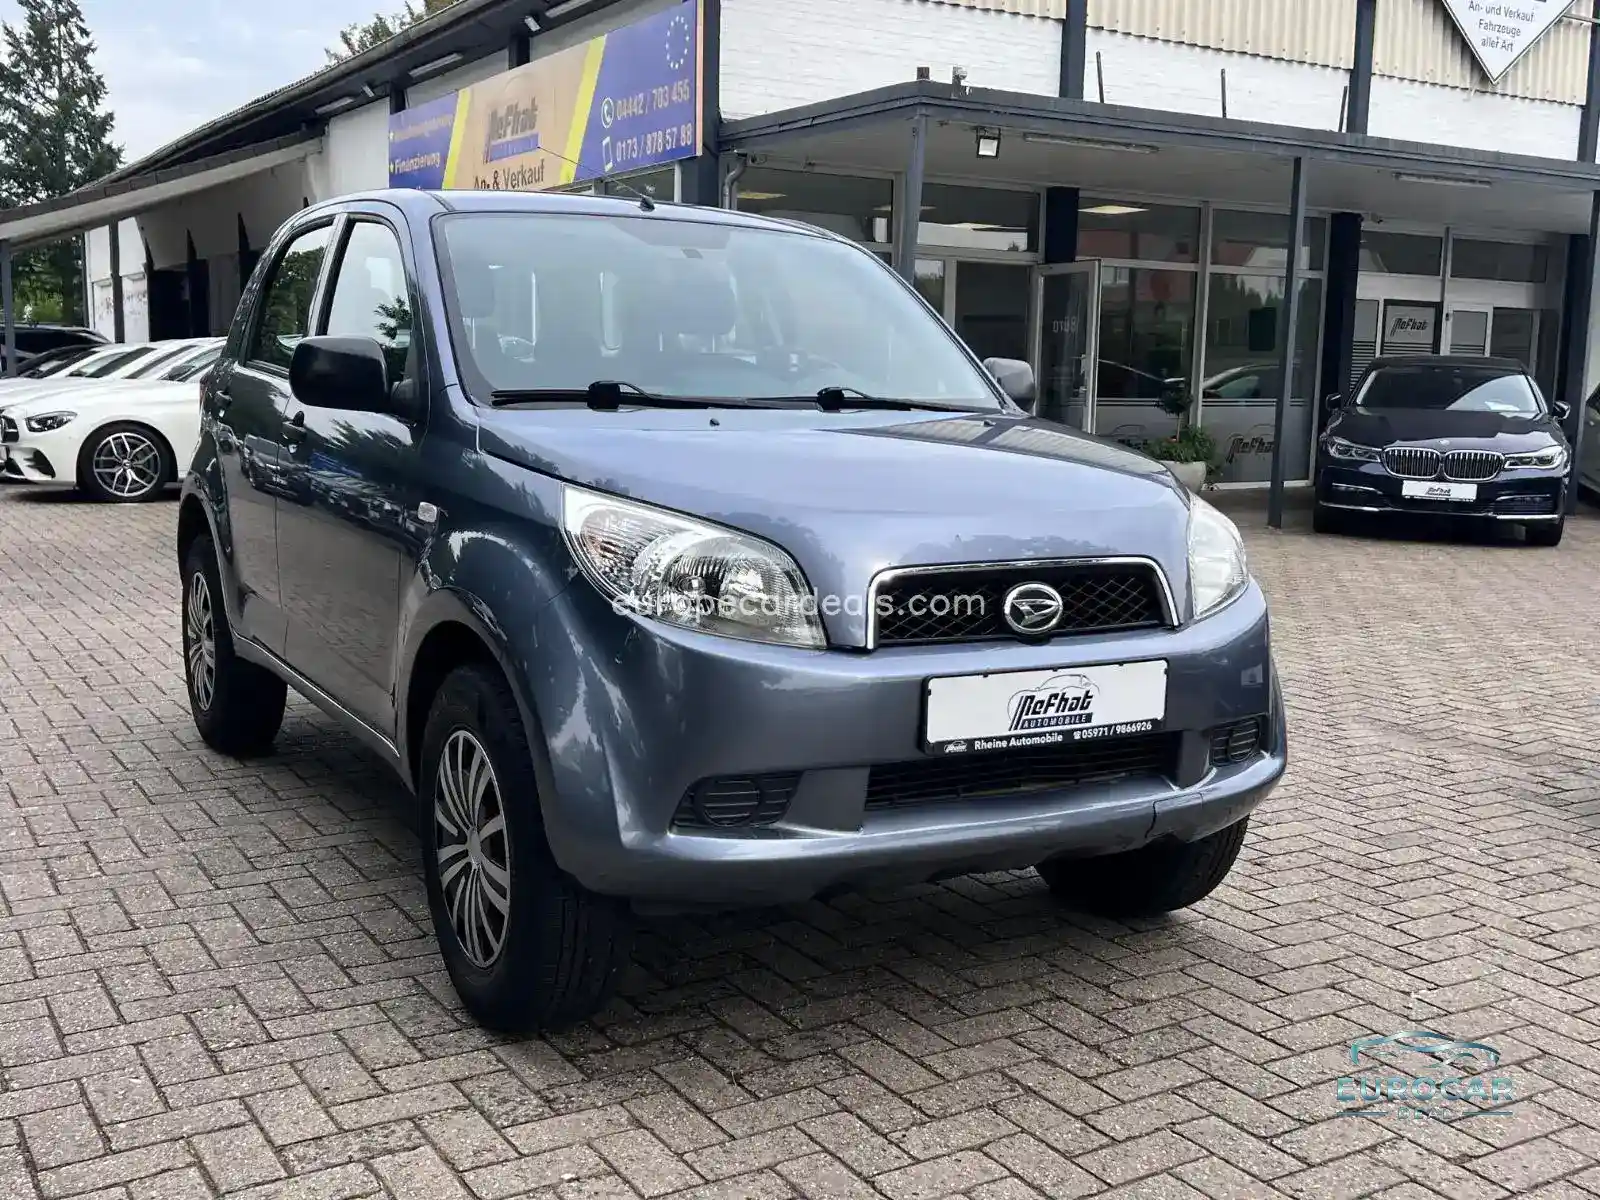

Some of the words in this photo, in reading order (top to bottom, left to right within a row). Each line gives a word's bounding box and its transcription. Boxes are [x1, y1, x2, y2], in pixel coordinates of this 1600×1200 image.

[1468, 2, 1483, 12] An-
[1485, 5, 1501, 16] und
[1503, 7, 1535, 22] Verkauf
[1479, 19, 1521, 37] Fahrzeuge
[1481, 37, 1500, 48] aller
[1501, 41, 1513, 52] Art
[617, 93, 644, 120] 04442
[652, 86, 669, 110] 703
[616, 137, 638, 162] 0173
[647, 130, 663, 154] 878
[665, 126, 677, 150] 57
[680, 123, 692, 146] 88
[394, 152, 441, 174] Finanzierung
[492, 169, 501, 189] &
[502, 158, 545, 189] Verkauf
[1022, 714, 1087, 729] AUTOMOBILE
[974, 739, 1008, 750] Rheine
[1010, 732, 1063, 747] Automobile
[1082, 729, 1109, 739] 05971
[1116, 721, 1152, 735] 9866926
